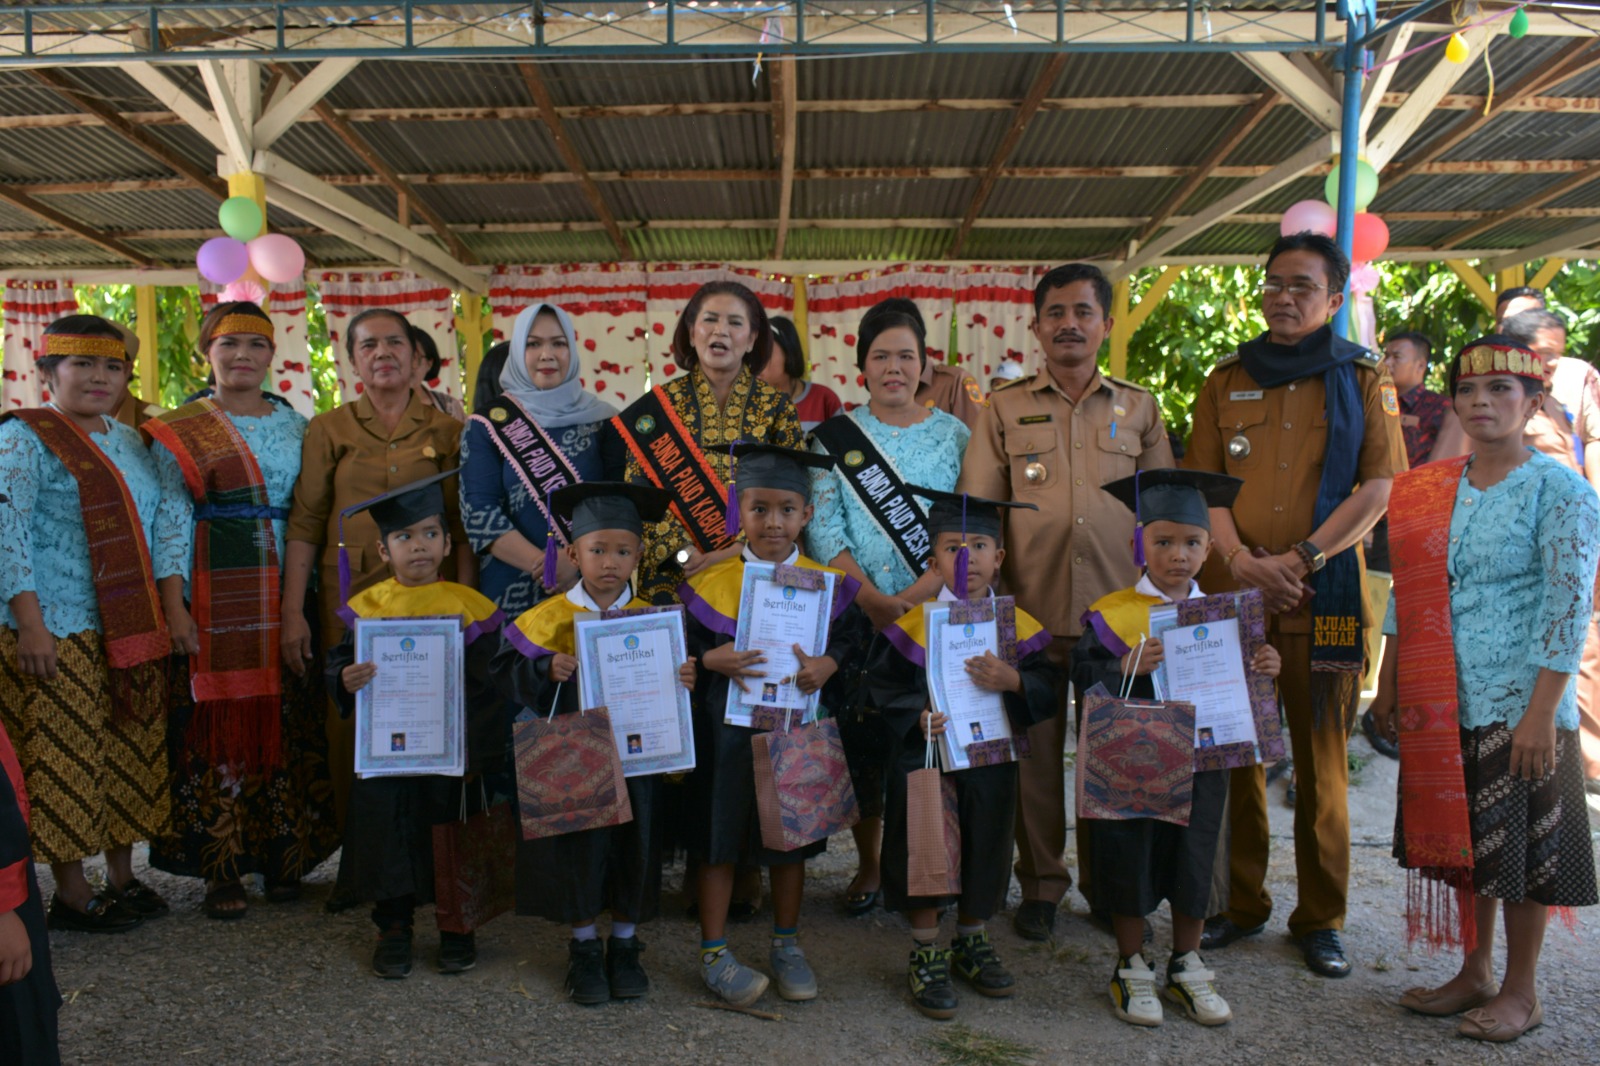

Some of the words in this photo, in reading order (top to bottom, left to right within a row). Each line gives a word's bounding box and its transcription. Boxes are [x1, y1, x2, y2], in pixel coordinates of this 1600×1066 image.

[501, 417, 538, 452] BUNDA
[522, 447, 557, 479] PAUD
[649, 432, 685, 475] BUNDA
[670, 466, 705, 504] PAUD
[856, 463, 896, 504] BUNDA
[880, 495, 916, 530] PAUD
[901, 523, 930, 560] DESA
[763, 598, 807, 612] Sertifikat
[949, 637, 987, 650] Sertifikat
[1175, 638, 1223, 655] Sertifikat
[1314, 631, 1356, 647] NJUAH
[381, 652, 429, 663] Sertifikat
[607, 649, 654, 663] Sertifikat
